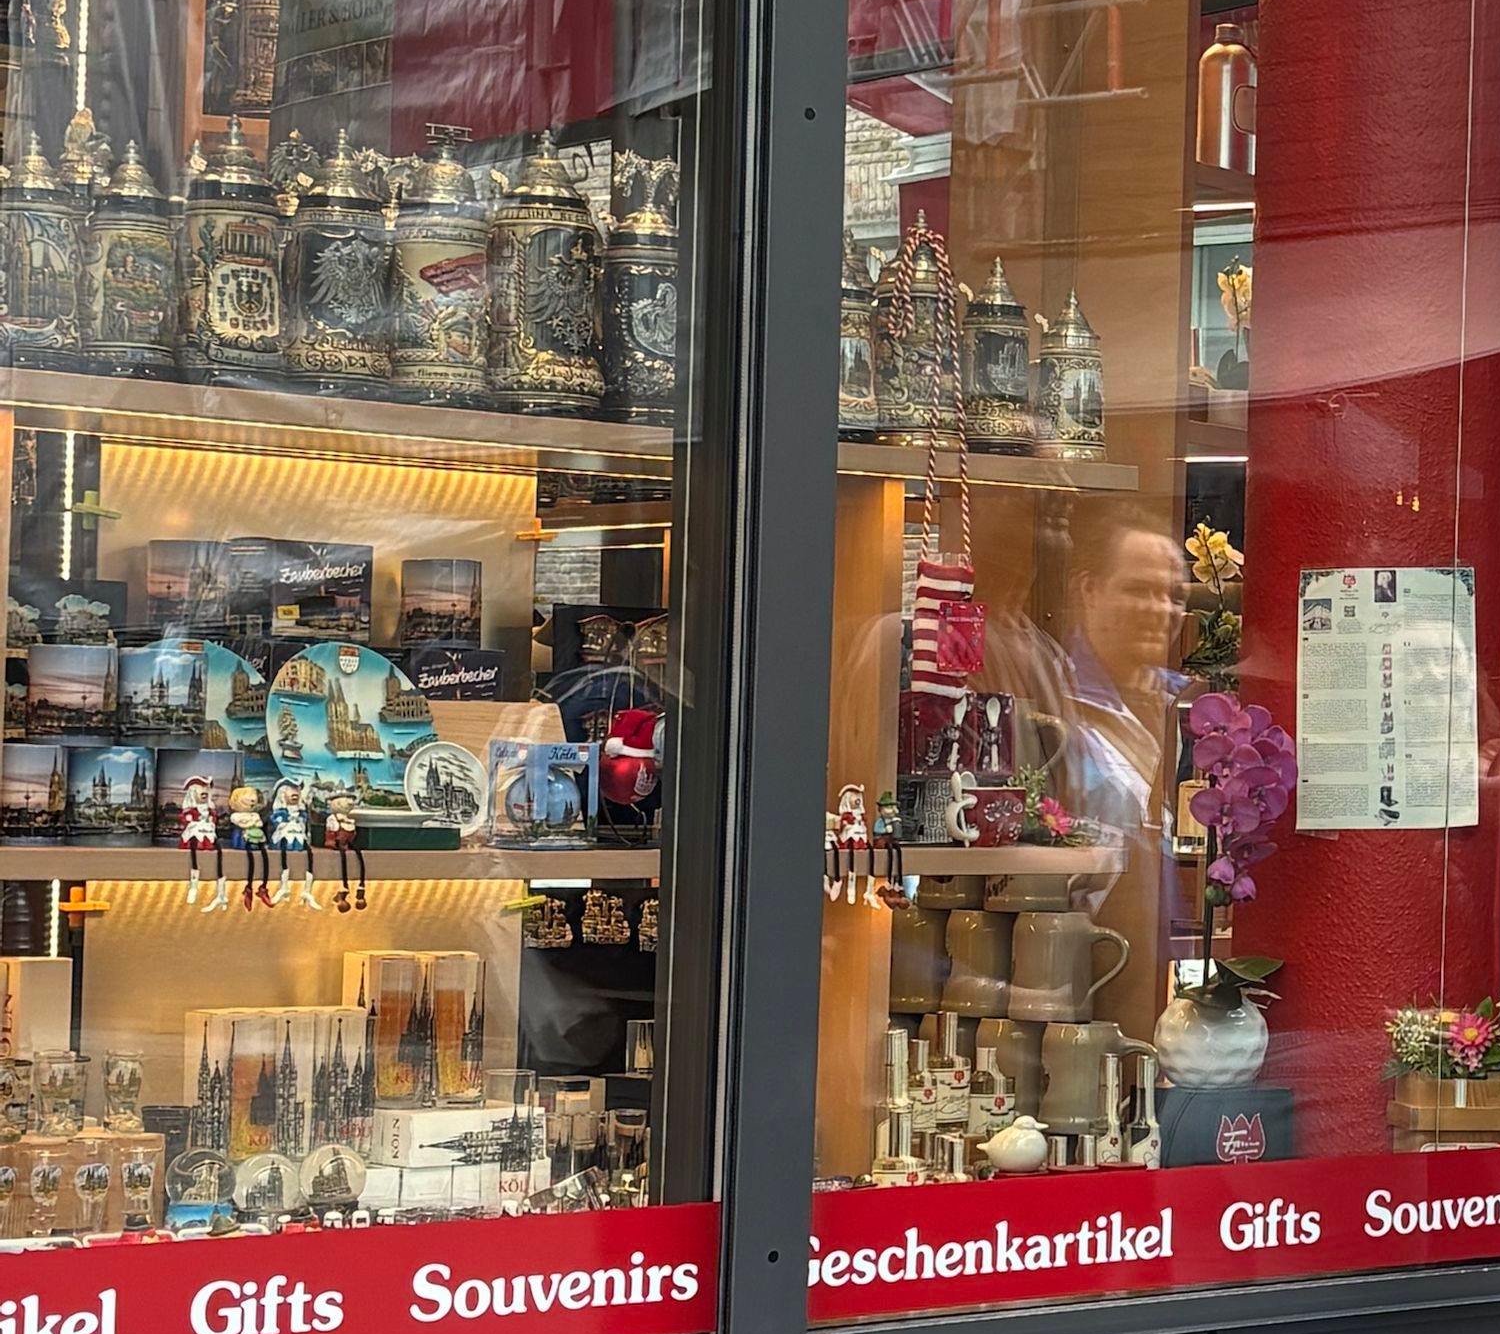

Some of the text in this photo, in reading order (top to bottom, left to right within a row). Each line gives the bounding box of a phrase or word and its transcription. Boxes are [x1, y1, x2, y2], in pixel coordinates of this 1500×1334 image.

[279, 561, 367, 585] Zauberbecher
[417, 666, 499, 690] Zauberbecher
[807, 1207, 1174, 1288] eschenkartikel
[1219, 1198, 1323, 1253] Gifts
[408, 1251, 699, 1323] Souvenirs
